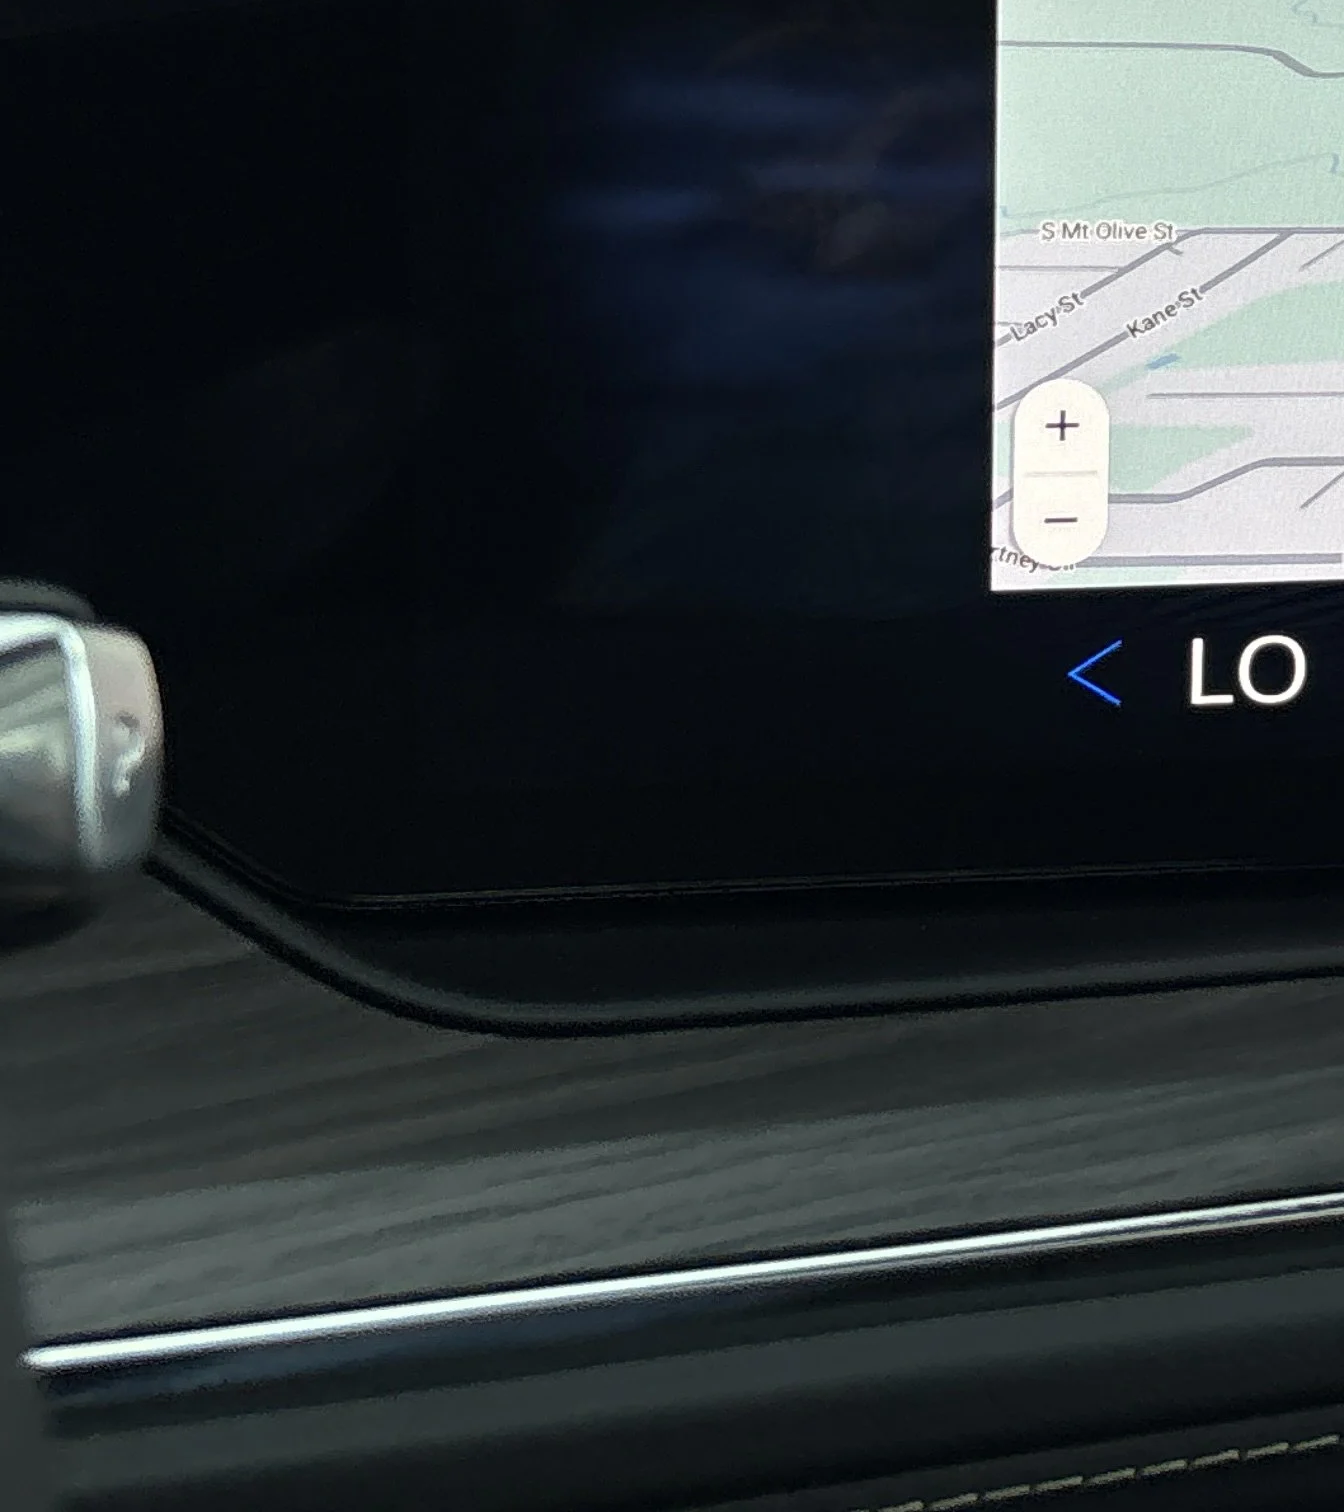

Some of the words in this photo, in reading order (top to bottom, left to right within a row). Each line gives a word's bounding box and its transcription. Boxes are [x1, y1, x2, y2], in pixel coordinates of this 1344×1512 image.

[1042, 223, 1054, 241] S
[1062, 222, 1089, 240] Mt
[1095, 221, 1146, 241] Olive
[1153, 222, 1174, 241] St
[1009, 309, 1058, 342] Lacy
[1057, 291, 1084, 316] St
[1126, 301, 1178, 339] Kane
[1177, 287, 1203, 312] St
[1190, 634, 1307, 706] LO
